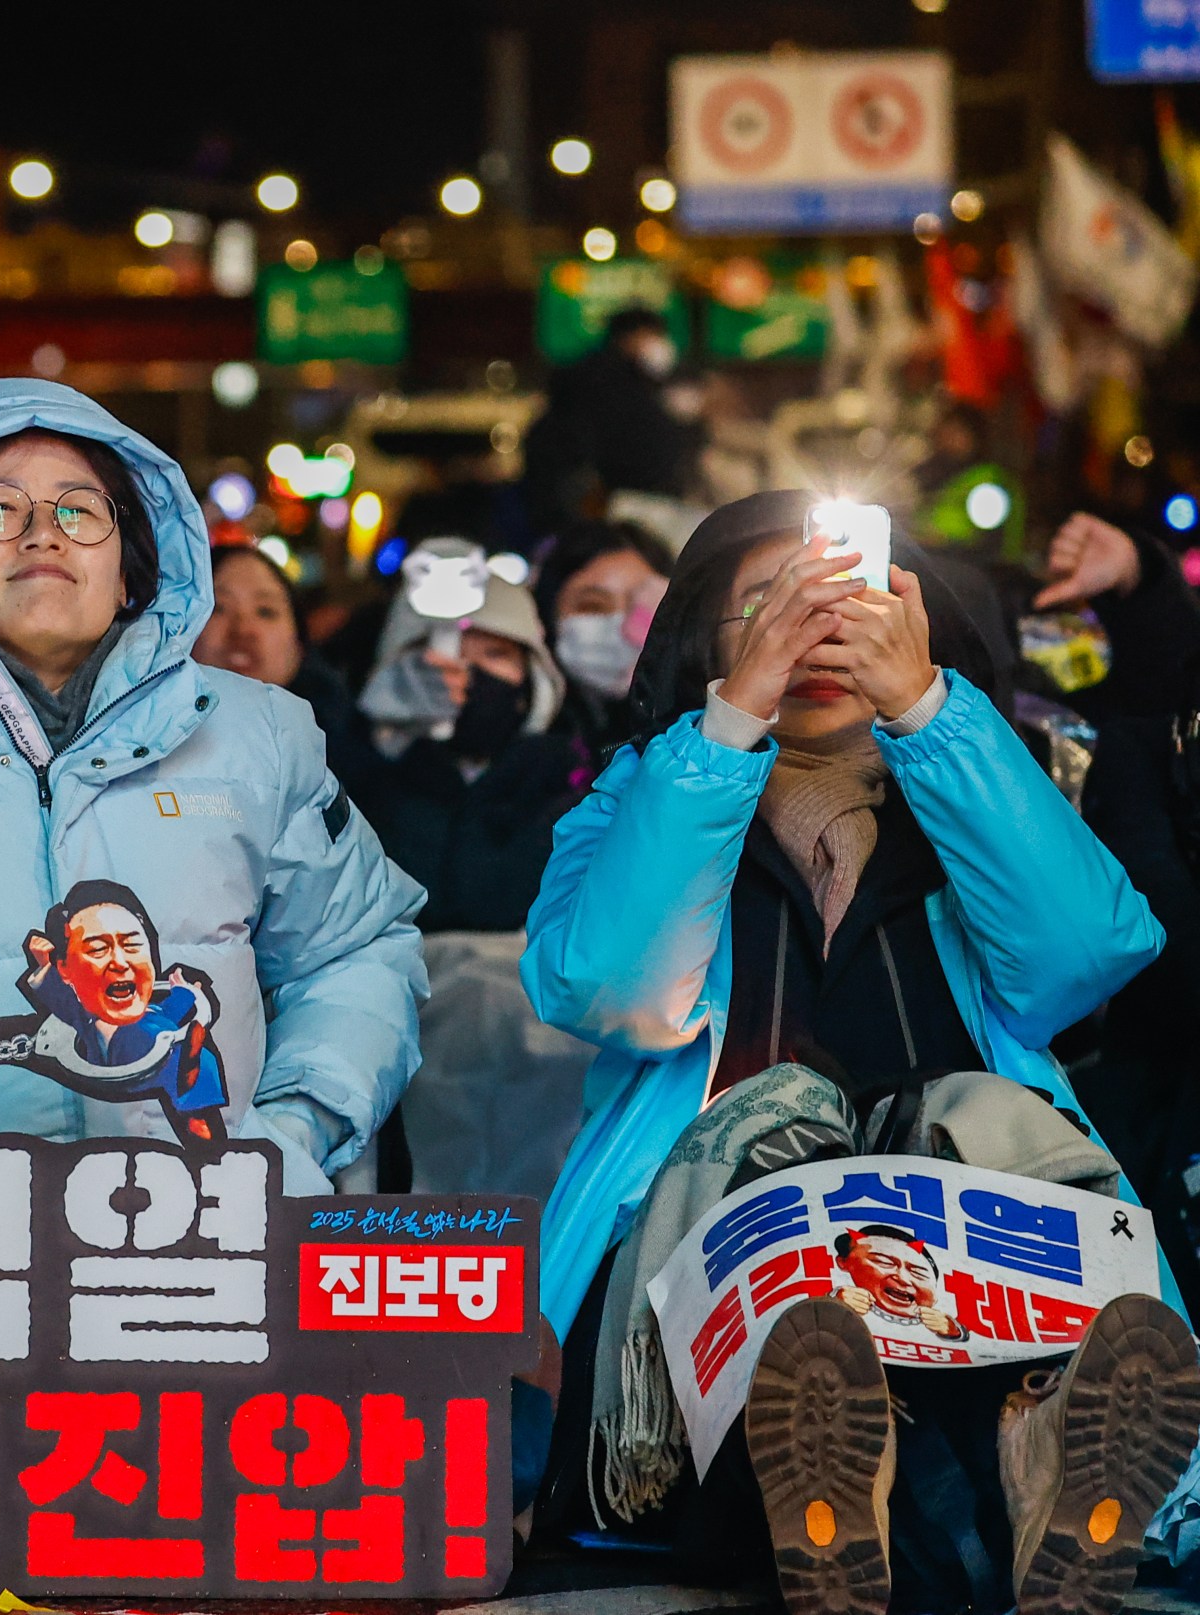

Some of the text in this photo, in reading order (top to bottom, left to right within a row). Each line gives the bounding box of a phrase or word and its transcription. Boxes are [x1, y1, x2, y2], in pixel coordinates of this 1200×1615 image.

[1, 703, 40, 761] GEOGRAPHIC
[180, 793, 233, 807] NATIONAL
[183, 805, 243, 823] GEOGRAPHIC
[310, 1209, 357, 1235] 2025
[358, 1206, 427, 1239] 윤석열
[459, 1206, 524, 1239] 나라
[702, 1172, 1083, 1292] 윤석열
[318, 1255, 506, 1321] 진보당
